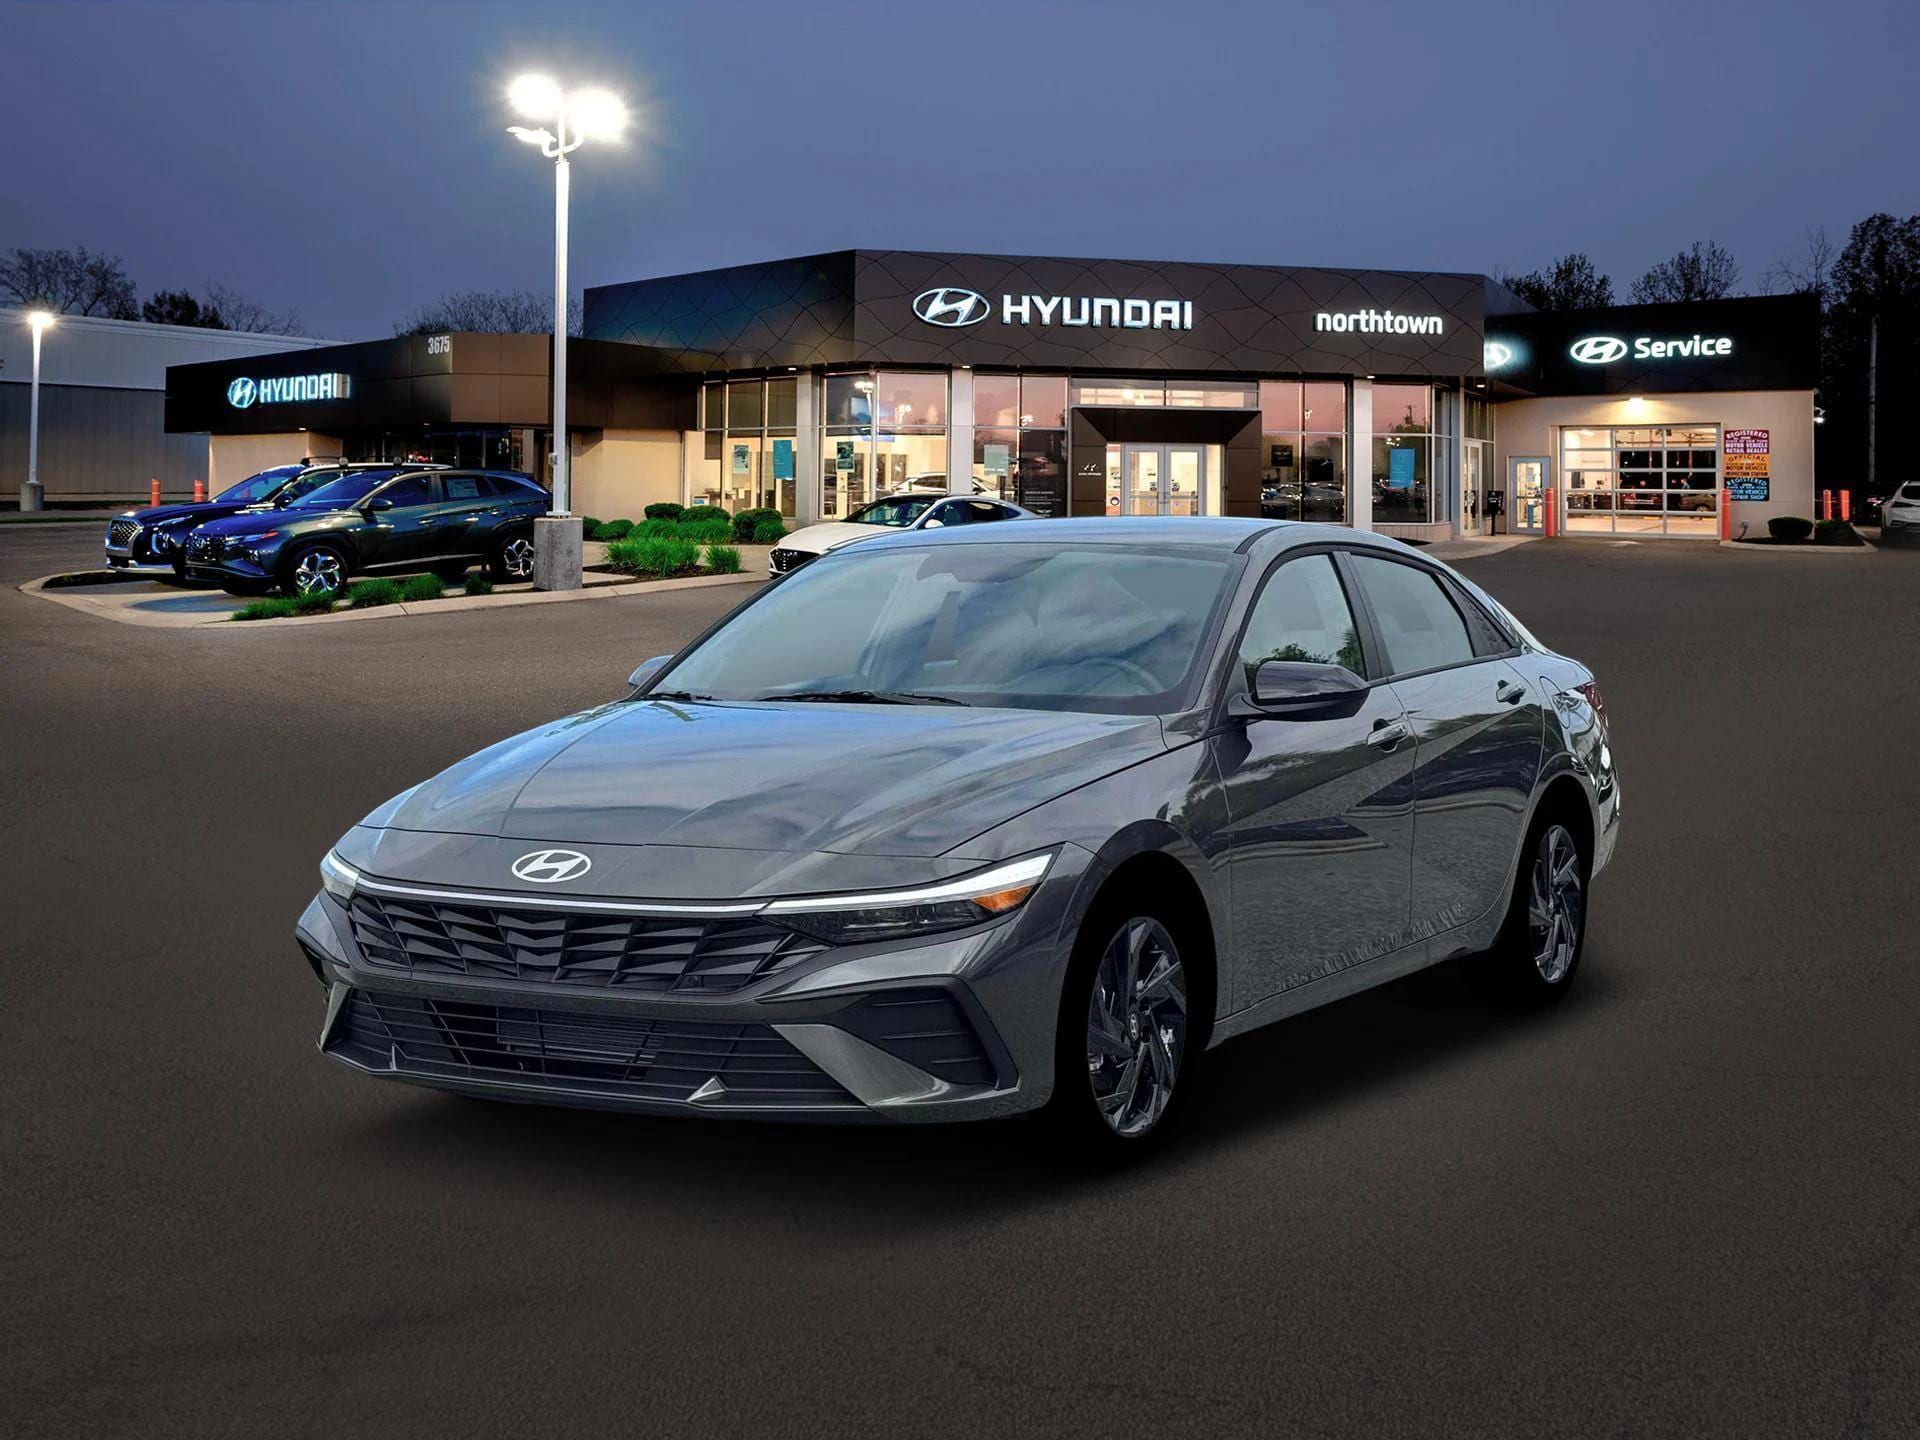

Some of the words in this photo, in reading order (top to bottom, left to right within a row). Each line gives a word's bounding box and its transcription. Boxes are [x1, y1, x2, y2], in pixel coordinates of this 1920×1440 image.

[1002, 294, 1193, 330] HYUNDAI
[1316, 309, 1443, 335] northtown
[428, 336, 451, 354] 3675
[1634, 334, 1733, 359] Service
[259, 372, 350, 403] HYUNDAI
[1726, 430, 1768, 439] REGISTERED
[1726, 477, 1767, 486] REGISTERED
